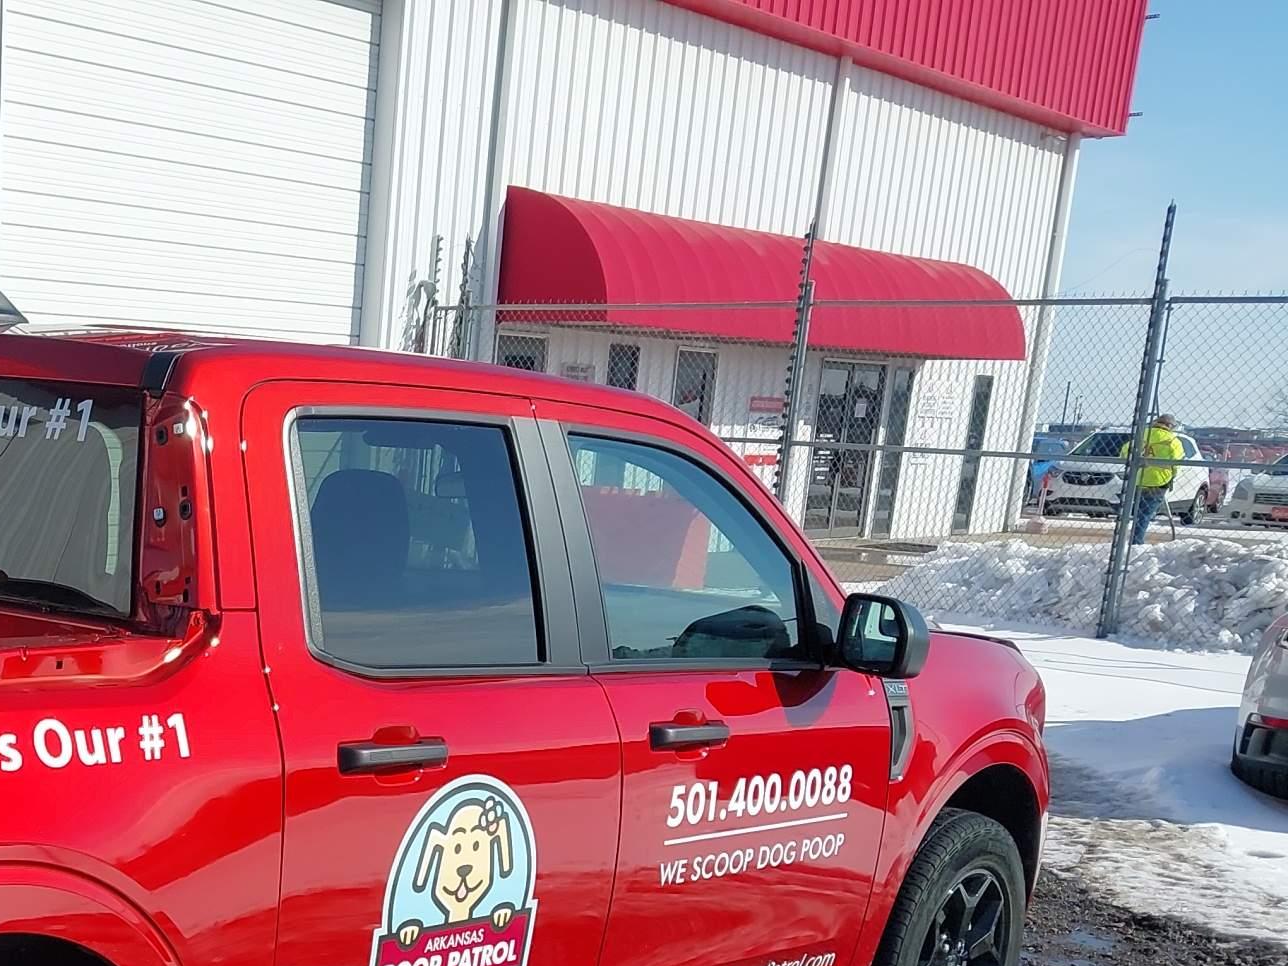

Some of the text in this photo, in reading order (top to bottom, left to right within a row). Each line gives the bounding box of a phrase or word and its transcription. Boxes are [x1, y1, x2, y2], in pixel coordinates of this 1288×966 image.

[45, 398, 93, 442] #1
[887, 682, 909, 693] XLT
[33, 718, 125, 768] Our
[138, 712, 191, 761] #1
[666, 764, 853, 828] 501.400.0088
[660, 833, 845, 886] WE SCOOP DOG POOP
[423, 928, 485, 953] ARKANSAS
